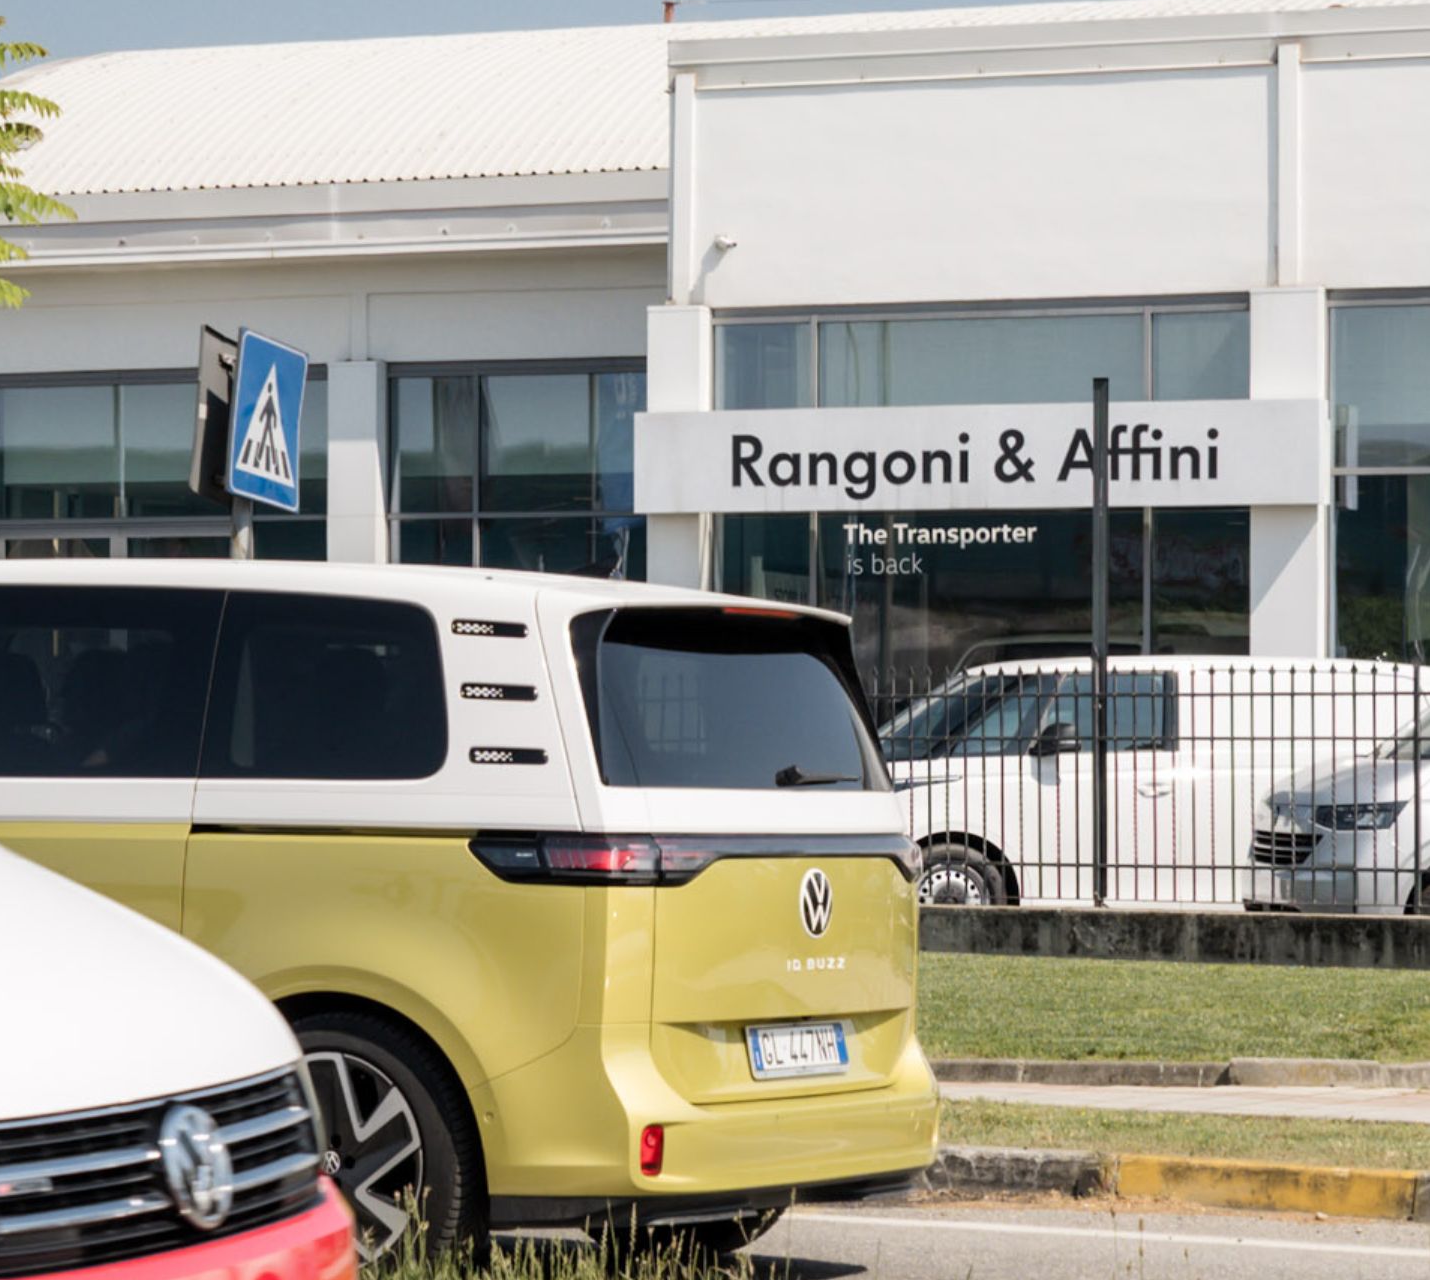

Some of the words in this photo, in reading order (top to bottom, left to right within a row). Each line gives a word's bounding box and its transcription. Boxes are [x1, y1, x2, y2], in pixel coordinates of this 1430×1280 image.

[731, 432, 969, 500] Rangoni
[994, 428, 1035, 483] &
[1057, 424, 1219, 483] Affini
[843, 523, 887, 545] The
[893, 523, 1038, 550] Transporter
[847, 554, 864, 575] is
[871, 552, 923, 575] back
